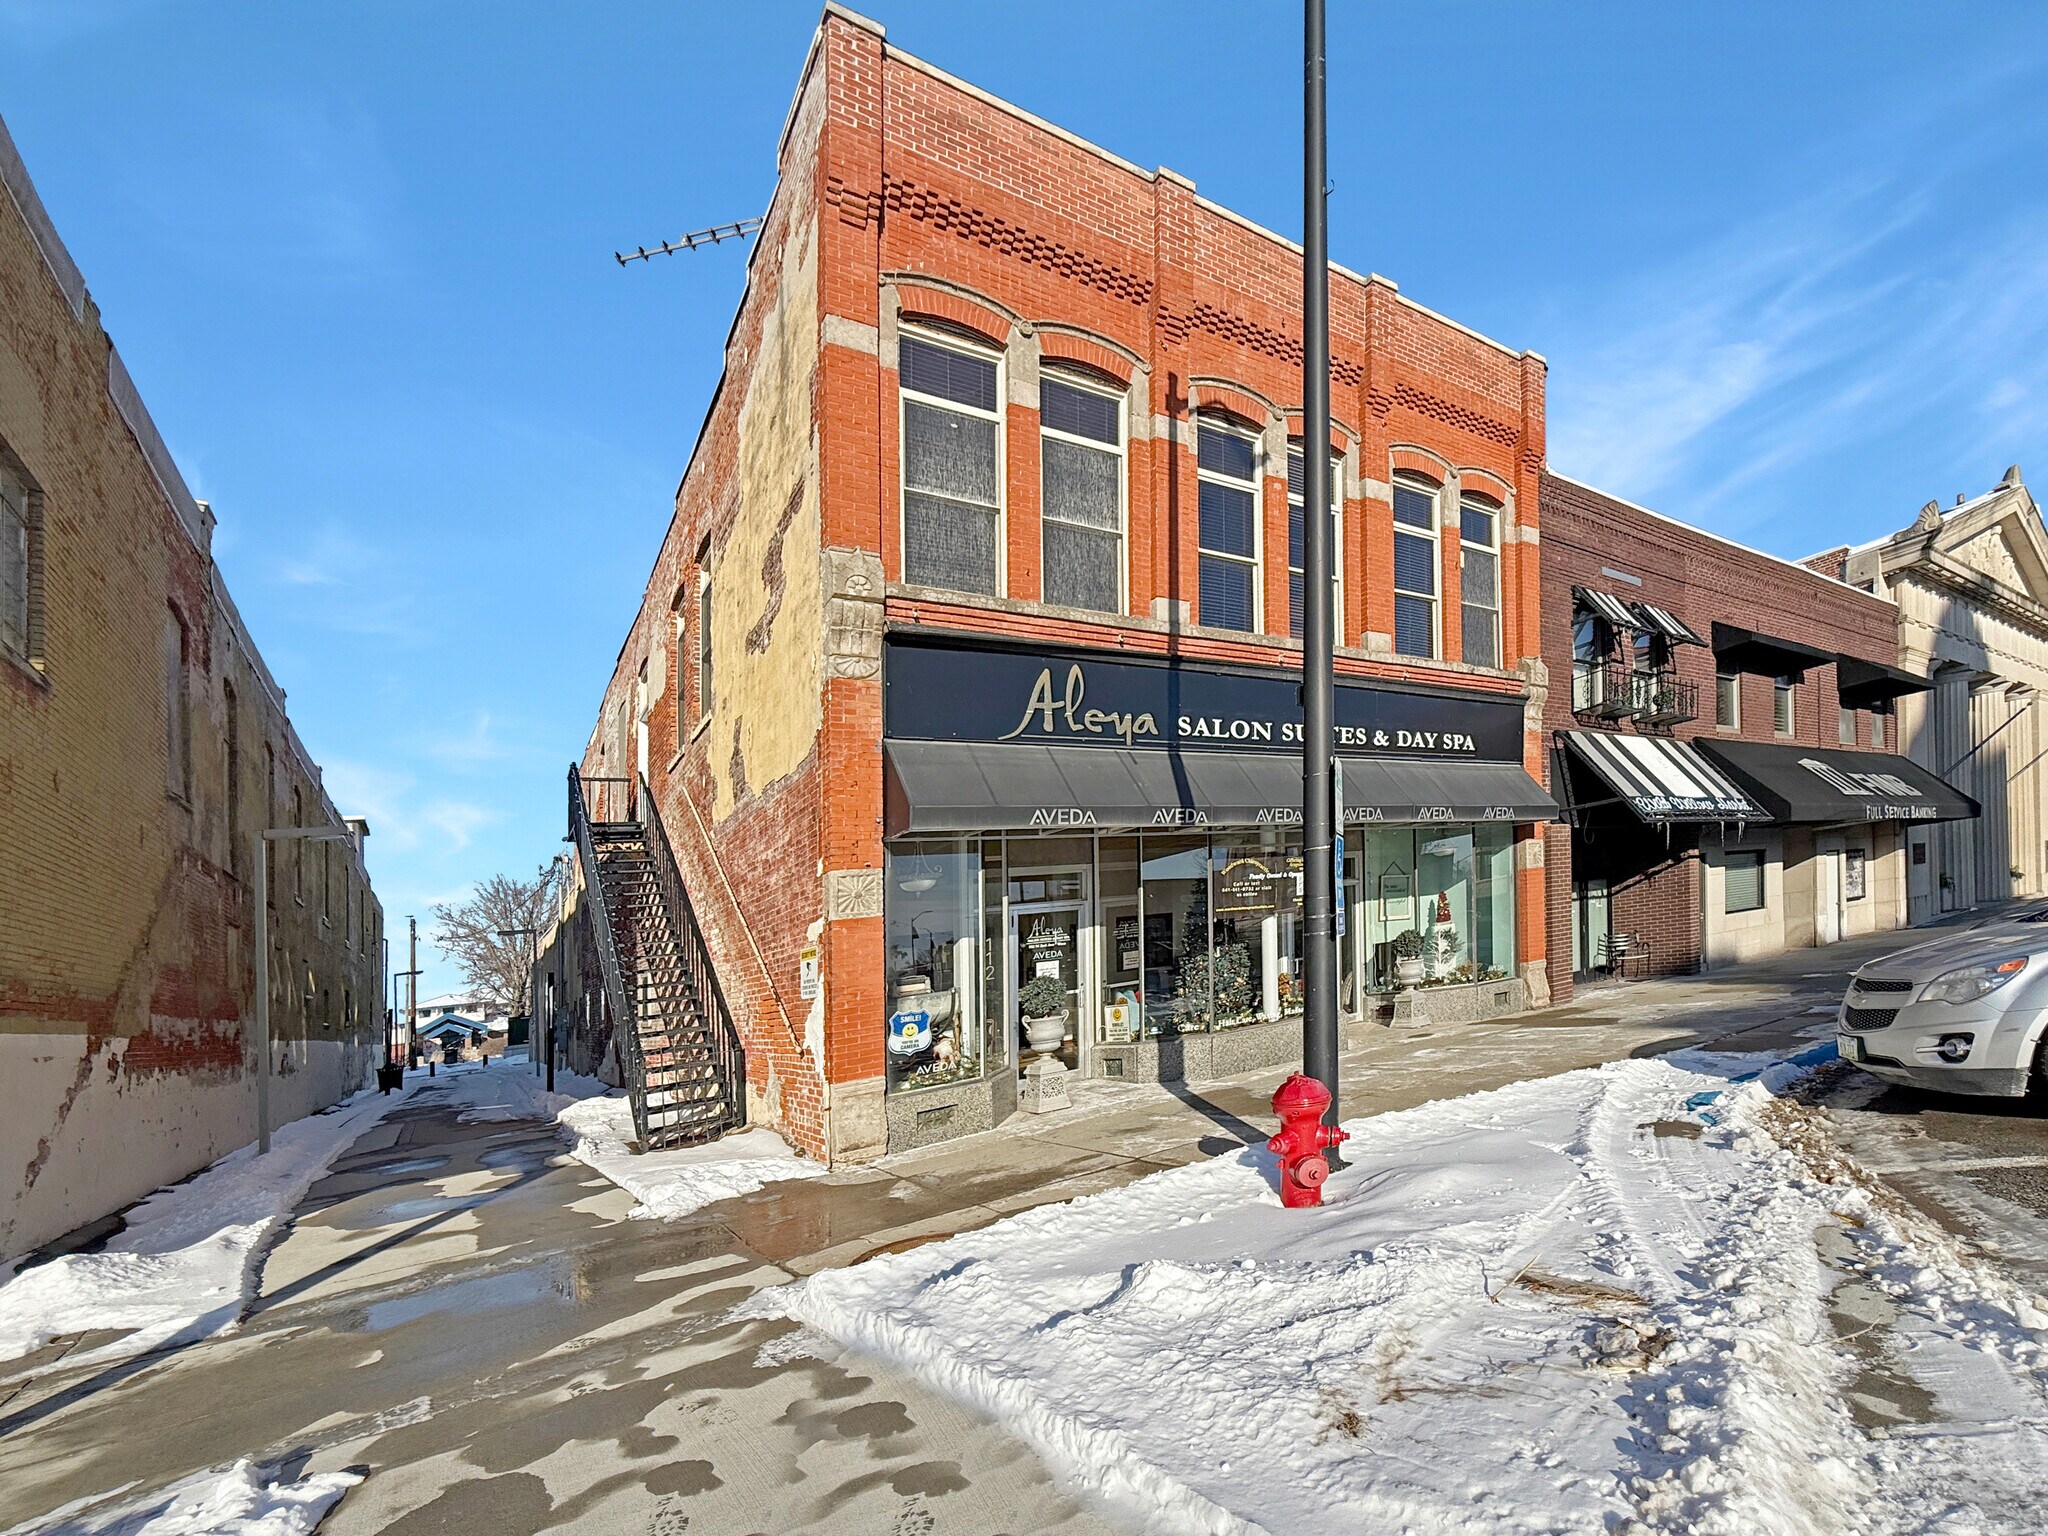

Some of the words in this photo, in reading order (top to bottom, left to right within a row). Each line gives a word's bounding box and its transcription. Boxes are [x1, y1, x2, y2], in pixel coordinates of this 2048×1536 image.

[998, 663, 1158, 746] Aleya
[1178, 716, 1272, 741] SALON
[1281, 723, 1367, 745] SUES
[1374, 730, 1389, 747] &
[1396, 730, 1438, 748] DAY
[1443, 733, 1476, 751] SPA
[1847, 773, 1923, 796] FNB
[1029, 808, 1097, 825] AVEDA
[1151, 808, 1208, 824] AVEDA
[1255, 808, 1303, 822] AVEDA
[1343, 808, 1384, 821] AVEDA
[1417, 807, 1454, 820] AVEDA
[1482, 807, 1515, 819] AVEDA
[1866, 805, 1883, 819] FULL
[1884, 804, 1910, 819] SERVICE
[1911, 805, 1937, 819] BANKING
[985, 937, 995, 980] 112
[1033, 950, 1063, 960] AVEDA
[901, 1014, 922, 1023] SMILE!
[916, 1061, 957, 1076] AVEDA
